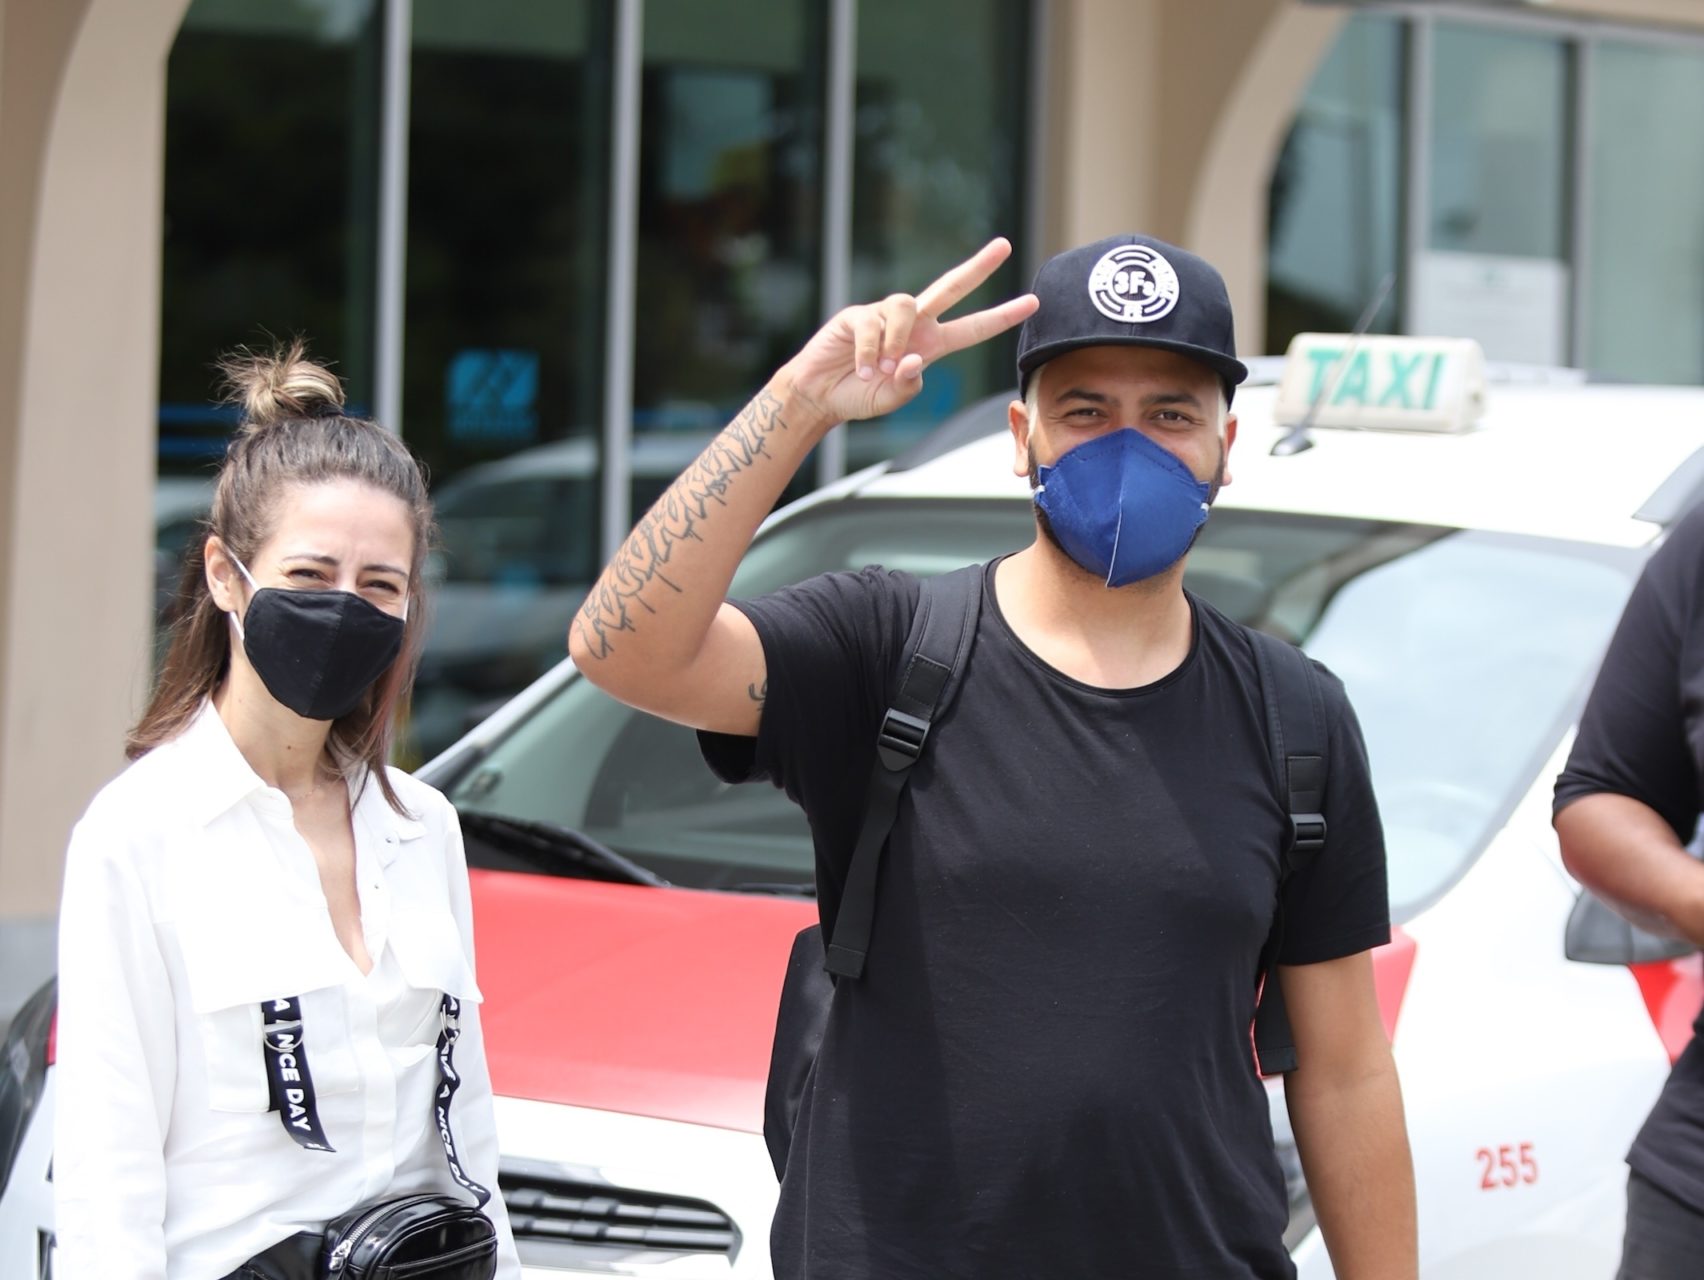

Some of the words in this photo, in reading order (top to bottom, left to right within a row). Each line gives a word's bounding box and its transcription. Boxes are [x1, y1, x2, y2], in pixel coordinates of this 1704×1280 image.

[1307, 348, 1446, 410] TAXI
[276, 1033, 301, 1082] NICE
[285, 1088, 312, 1132] DAY
[438, 1105, 455, 1158] NICE
[1475, 1143, 1538, 1190] 255
